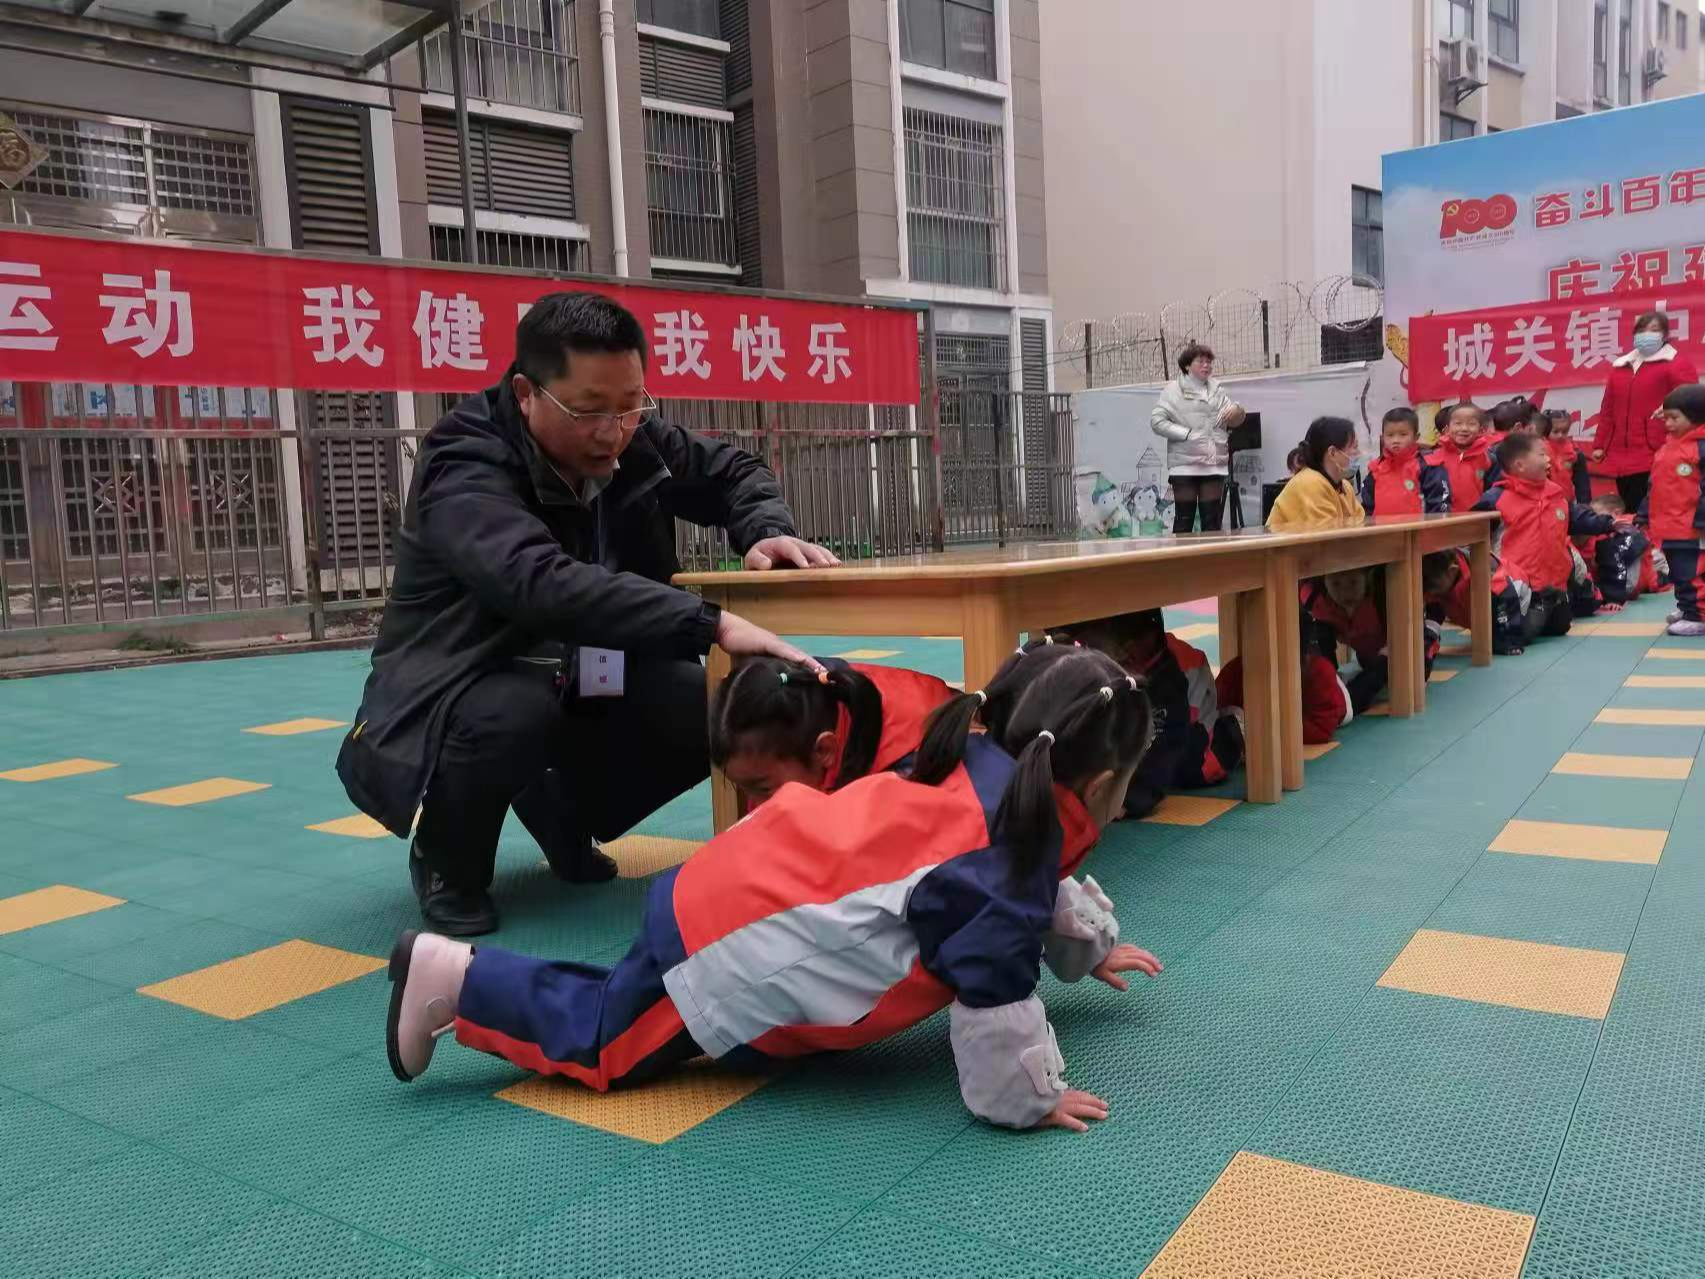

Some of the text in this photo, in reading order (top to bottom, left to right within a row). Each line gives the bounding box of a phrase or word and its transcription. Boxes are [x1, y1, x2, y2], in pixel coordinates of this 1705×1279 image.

[1535, 167, 1705, 228] 奋斗百年
[0, 260, 853, 385] 运动 我健 我快乐
